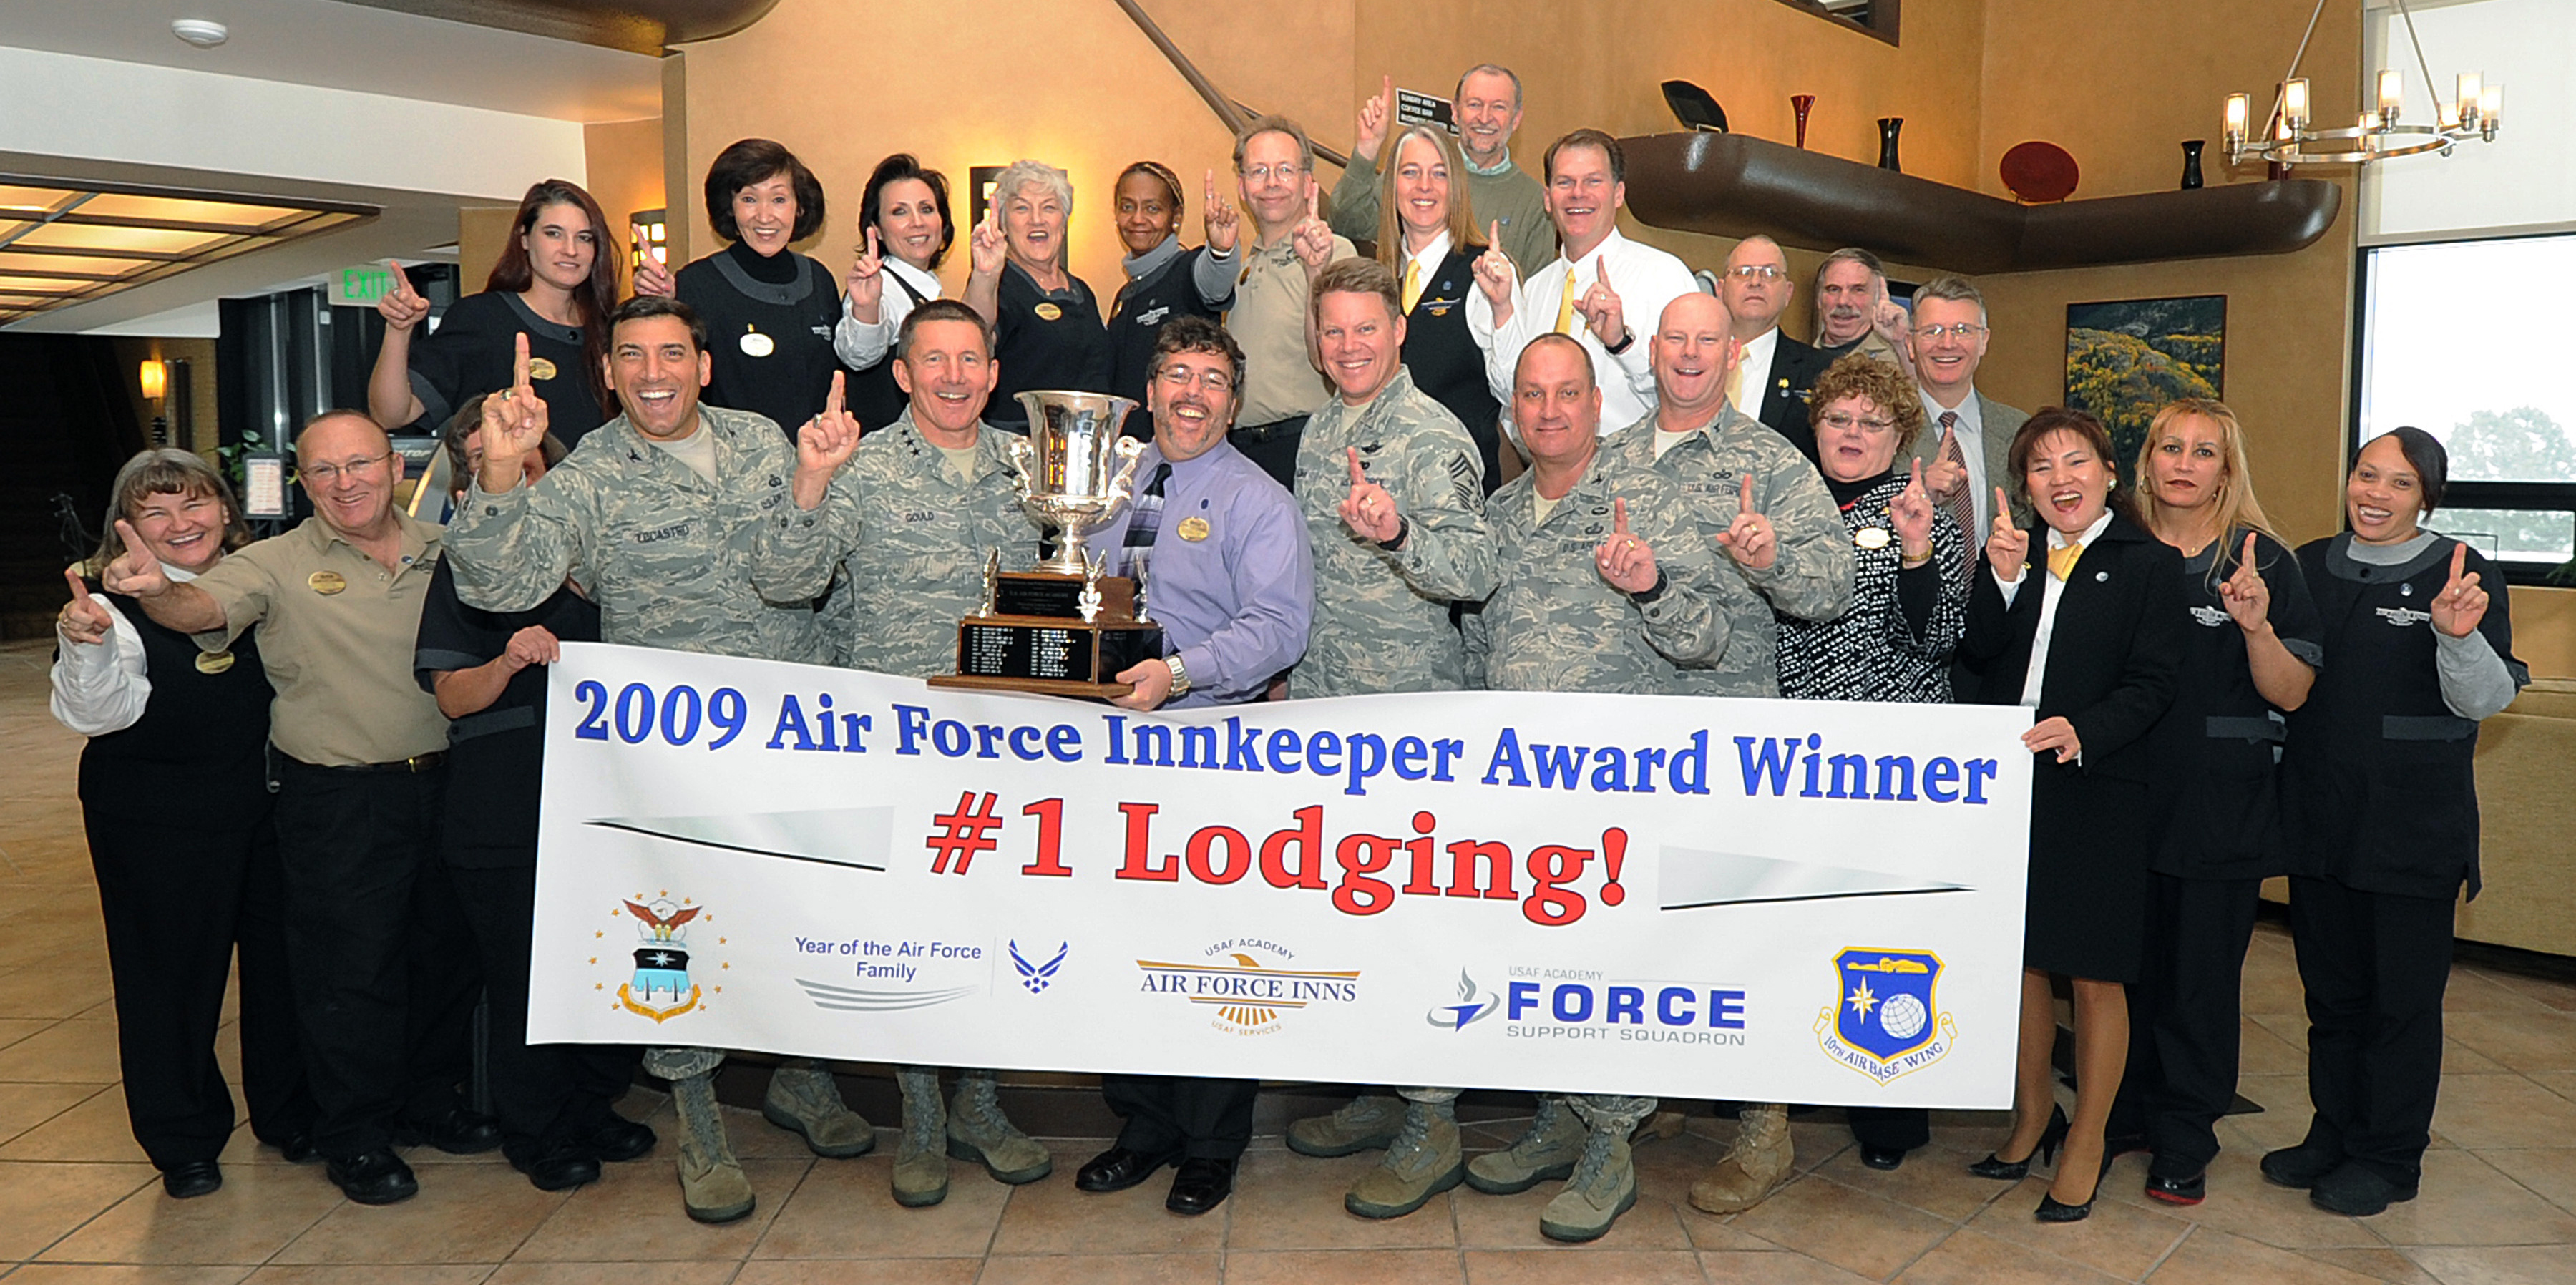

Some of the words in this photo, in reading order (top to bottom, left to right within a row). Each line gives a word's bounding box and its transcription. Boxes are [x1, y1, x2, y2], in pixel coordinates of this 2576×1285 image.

[343, 269, 388, 299] EXIT
[905, 511, 935, 522] GOULD
[575, 680, 748, 751] 2009
[766, 693, 872, 753] Air
[892, 703, 1083, 763] Force
[1101, 714, 1465, 796] Innkeeper
[1481, 728, 1710, 795] Award
[1733, 733, 1998, 805] Winner
[926, 790, 1073, 878] #1
[1114, 801, 1629, 927] Lodging!
[794, 936, 835, 954] Year
[839, 939, 859, 955] of
[863, 940, 892, 957] the
[897, 941, 925, 958] Air
[930, 942, 982, 959] Force
[1204, 939, 1234, 957] USAF
[1238, 938, 1295, 961] ACADEMY
[856, 961, 917, 984] Family
[1508, 966, 1541, 978] USAF
[1543, 968, 1604, 982] ACADEMY
[1140, 973, 1188, 993] AIR
[1196, 975, 1284, 998] FORCE
[1292, 981, 1357, 1002] INNS
[1507, 980, 1745, 1030] FORCE
[1211, 1020, 1234, 1035] USAF
[1238, 1023, 1282, 1037] SERVICES
[1506, 1025, 1610, 1040] SUPPORT
[1619, 1028, 1745, 1046] SQUADRON
[1844, 1051, 1868, 1070] AIR
[1868, 1061, 1900, 1081] BASE
[1903, 1042, 1943, 1068] WING
